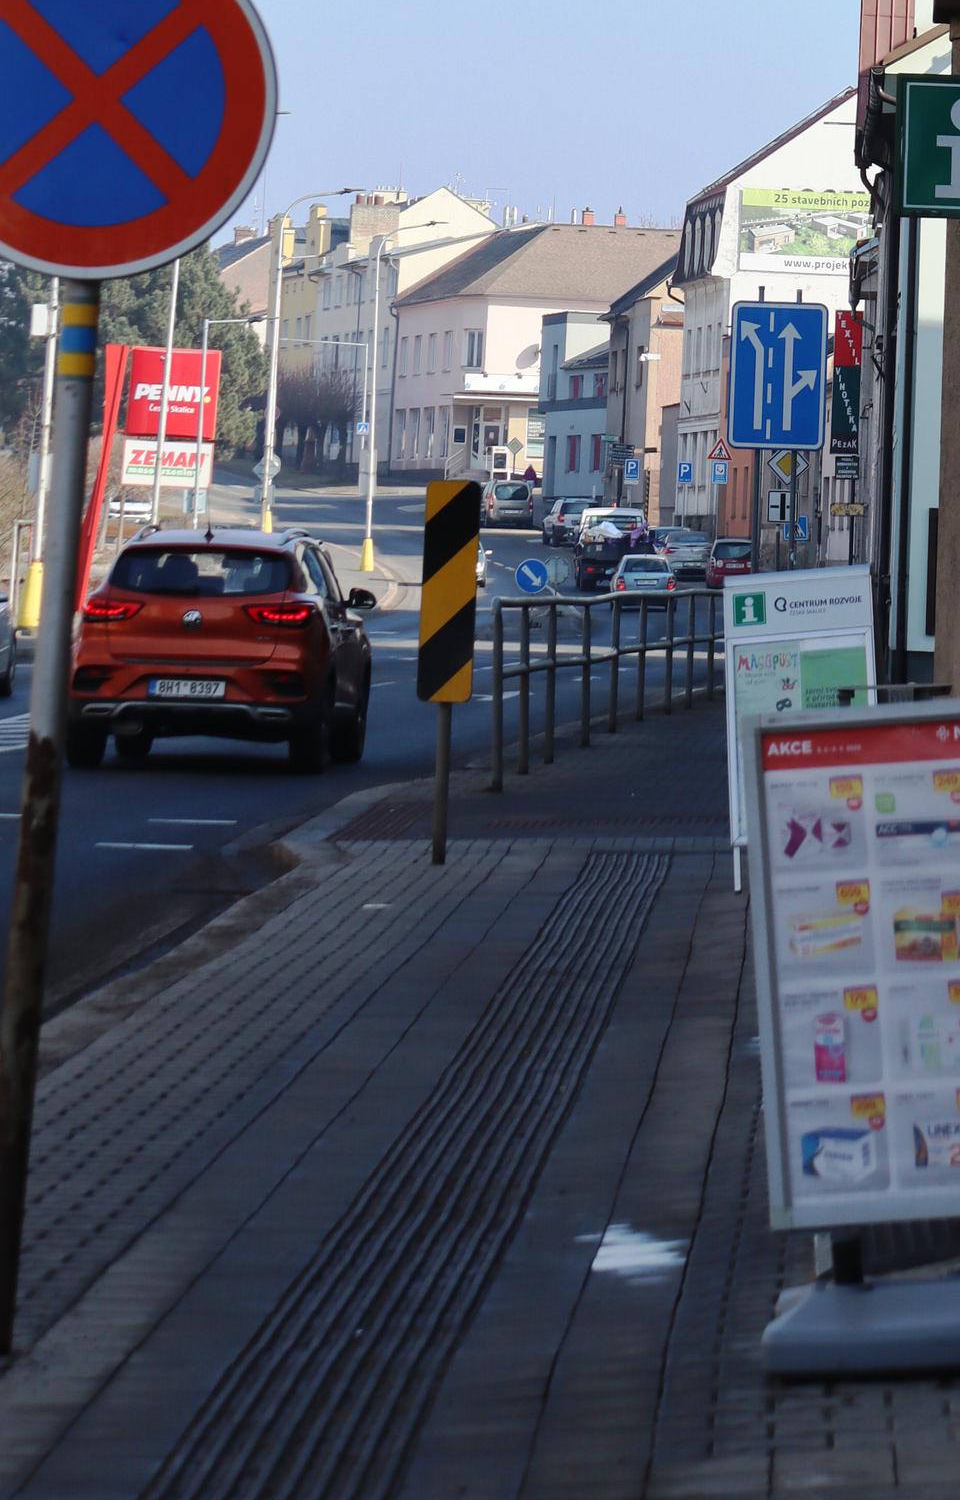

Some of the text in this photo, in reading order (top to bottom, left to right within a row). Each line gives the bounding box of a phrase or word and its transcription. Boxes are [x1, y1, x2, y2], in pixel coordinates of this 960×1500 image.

[774, 194, 788, 204] 25
[792, 196, 848, 207] stavebních
[837, 311, 860, 366] TEXTIL
[835, 367, 858, 432] VINOTÉKA
[129, 449, 206, 468] ZEMAN
[789, 596, 862, 609] CENTRUM ROZVOJE
[738, 652, 798, 672] MASOPUST
[159, 681, 181, 693] 8H1
[768, 740, 812, 756] AKCE
